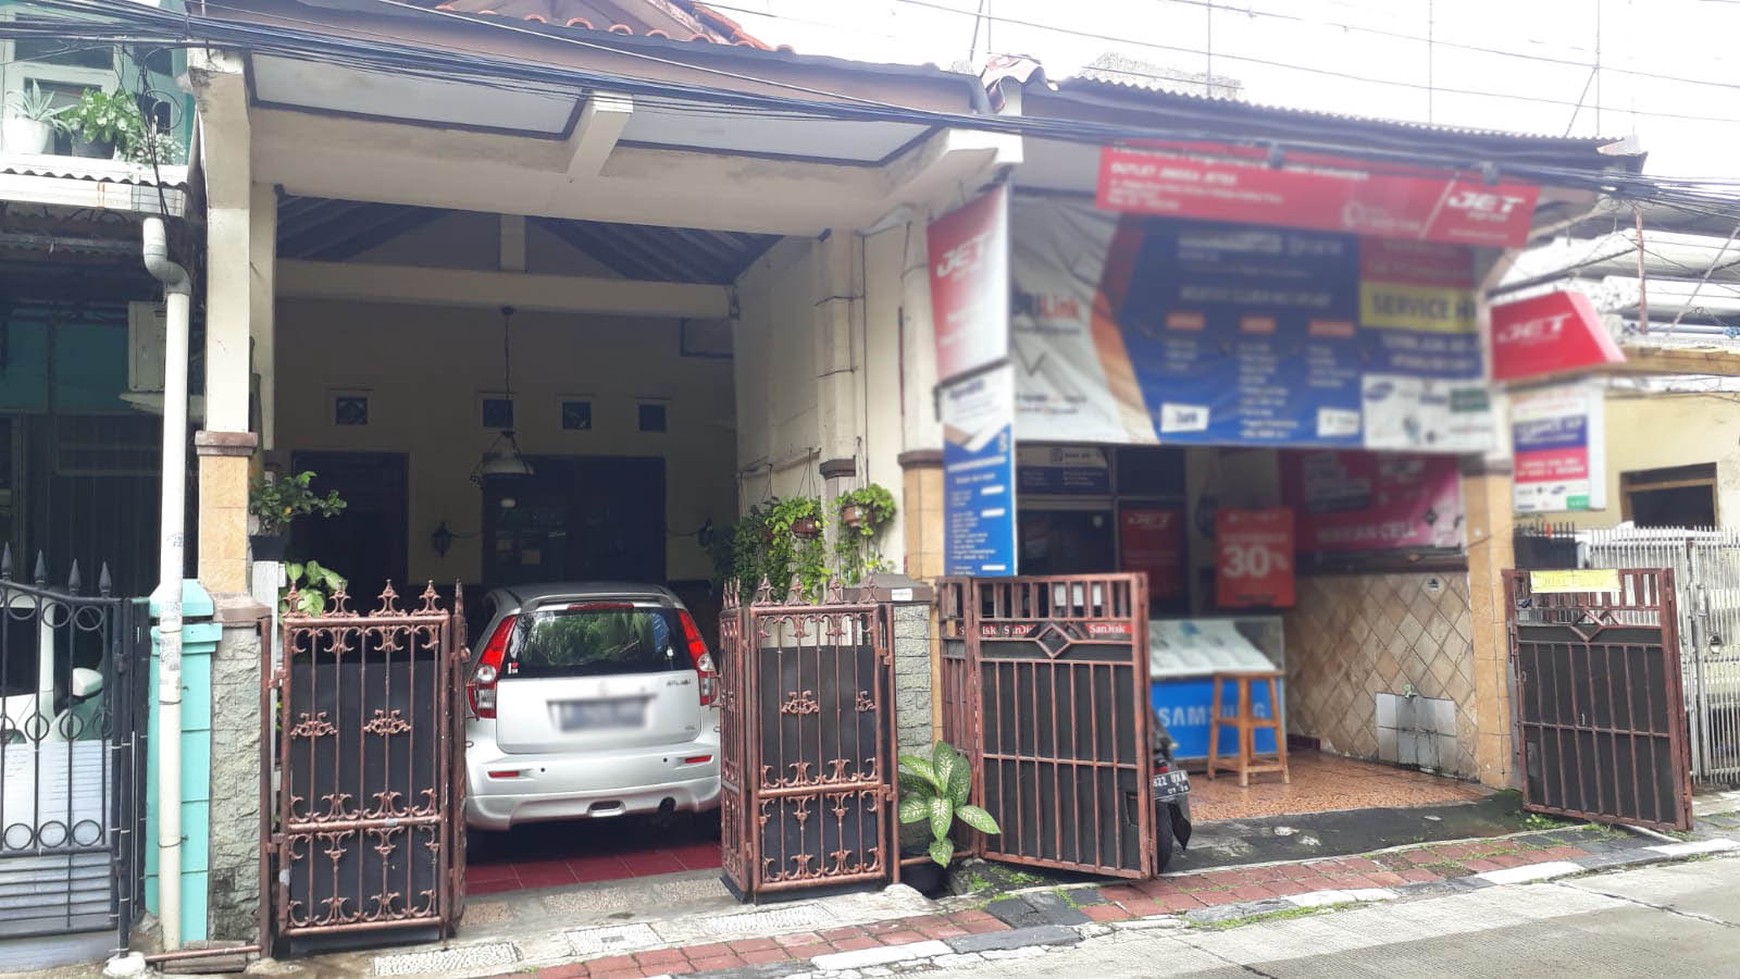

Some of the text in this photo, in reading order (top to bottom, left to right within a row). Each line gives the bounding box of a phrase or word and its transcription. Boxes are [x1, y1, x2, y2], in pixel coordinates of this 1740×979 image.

[1448, 191, 1525, 214] JET
[1373, 292, 1450, 320] SERVICE
[1496, 312, 1573, 344] JET
